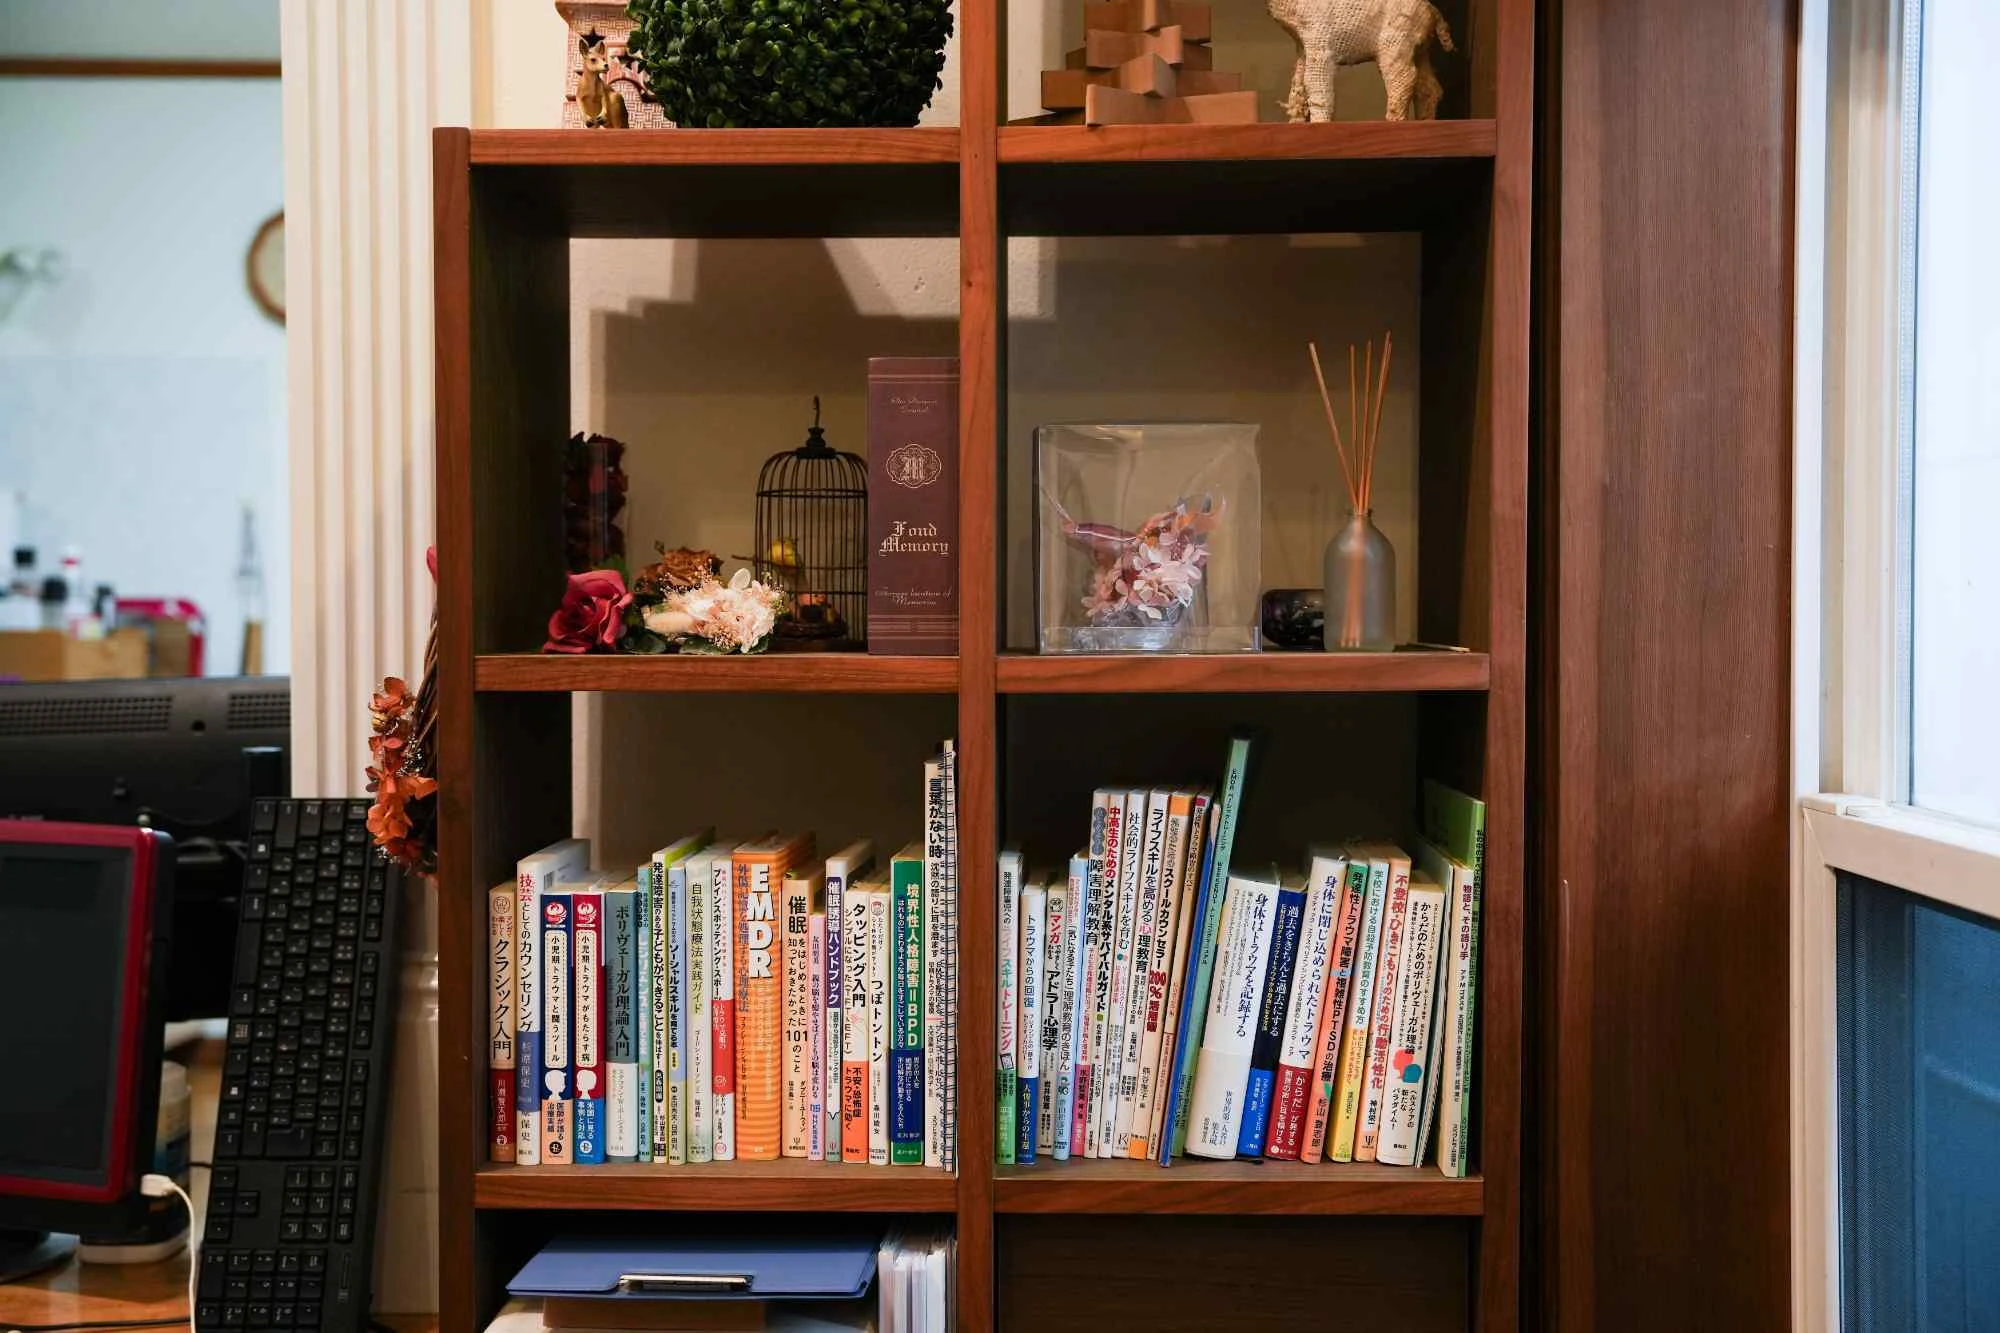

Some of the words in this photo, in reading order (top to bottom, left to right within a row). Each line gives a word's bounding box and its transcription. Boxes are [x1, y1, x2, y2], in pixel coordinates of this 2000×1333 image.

[879, 536, 950, 556] Memory
[889, 520, 938, 538] Fond
[747, 863, 775, 979] EMDR
[788, 895, 807, 934] 催眠
[1050, 914, 1062, 944] マンガ
[1086, 858, 1104, 946] 障害理解教育
[1096, 806, 1121, 1013] 中高生のためのメンタル系サバイバルガイド
[1118, 811, 1141, 950] 社会的ライフスキルを育む
[1135, 808, 1164, 973] ライフスキルを高める心理教育
[1459, 884, 1473, 961] 物語と、その語り手
[494, 938, 512, 1061] クラシック入門
[519, 873, 536, 1033] 技芸としてのカウンセリング
[551, 935, 561, 1062] 小児期トラウマと闘うツール
[581, 935, 591, 1062] 小児期トラウマがもたらす病
[615, 905, 630, 1057] ポリヴェーガル理論入門
[653, 862, 664, 1068] 発達障害のある子どもができることを伸ばす!
[691, 883, 704, 1014] 自我状態療法実践ガイド
[787, 937, 797, 1027] 知っておきたかった
[797, 937, 807, 1026] をはじめるときに
[827, 881, 841, 1005] 催眠誘導ハンドブック
[851, 903, 868, 1008] タッピング入門
[1024, 914, 1036, 1008] トラウマからの回復
[1060, 926, 1077, 1071] 「気になる子たち」理解教育のきほん
[1235, 893, 1268, 1038] 身体はトラウマを記録する
[1271, 905, 1299, 1038] 過去をきちんと過去にする
[1299, 875, 1338, 1060] 身体に閉じ込められたトラウマ
[1321, 871, 1363, 1083] 発達性トラウマ障害と複雑性PTSDの治療
[1355, 870, 1384, 1025] 学校における自殺予防教育のすすめ方
[1371, 874, 1408, 1090] 不登校・ひきこもりのための行動活性化
[1404, 902, 1431, 1056] からだのためのポリヴェーガル理論
[785, 1030, 808, 1042] 101
[792, 1044, 803, 1074] のこと
[871, 979, 883, 1063] つぼトントン
[1043, 970, 1060, 1051] アドラー心理学
[844, 1066, 853, 1131] トラウマに効く
[1400, 1089, 1408, 1112] 新たな
